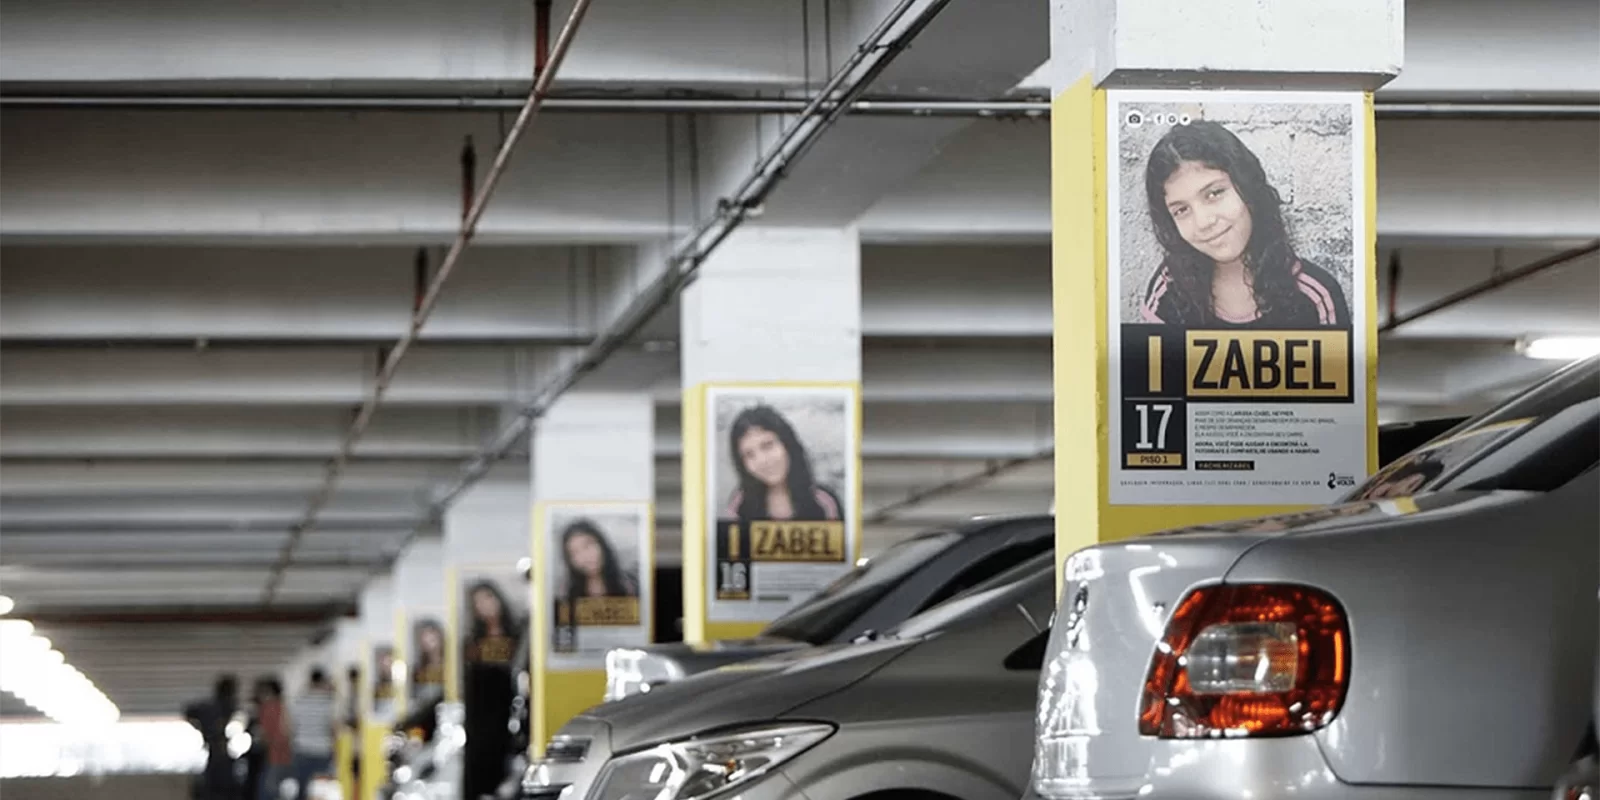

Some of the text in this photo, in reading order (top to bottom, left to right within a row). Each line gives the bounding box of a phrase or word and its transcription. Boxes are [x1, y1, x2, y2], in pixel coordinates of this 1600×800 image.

[1148, 335, 1337, 393] I ZABEL
[1135, 404, 1173, 450] 17
[1140, 453, 1160, 464] PISO
[756, 526, 836, 555] ZABEL
